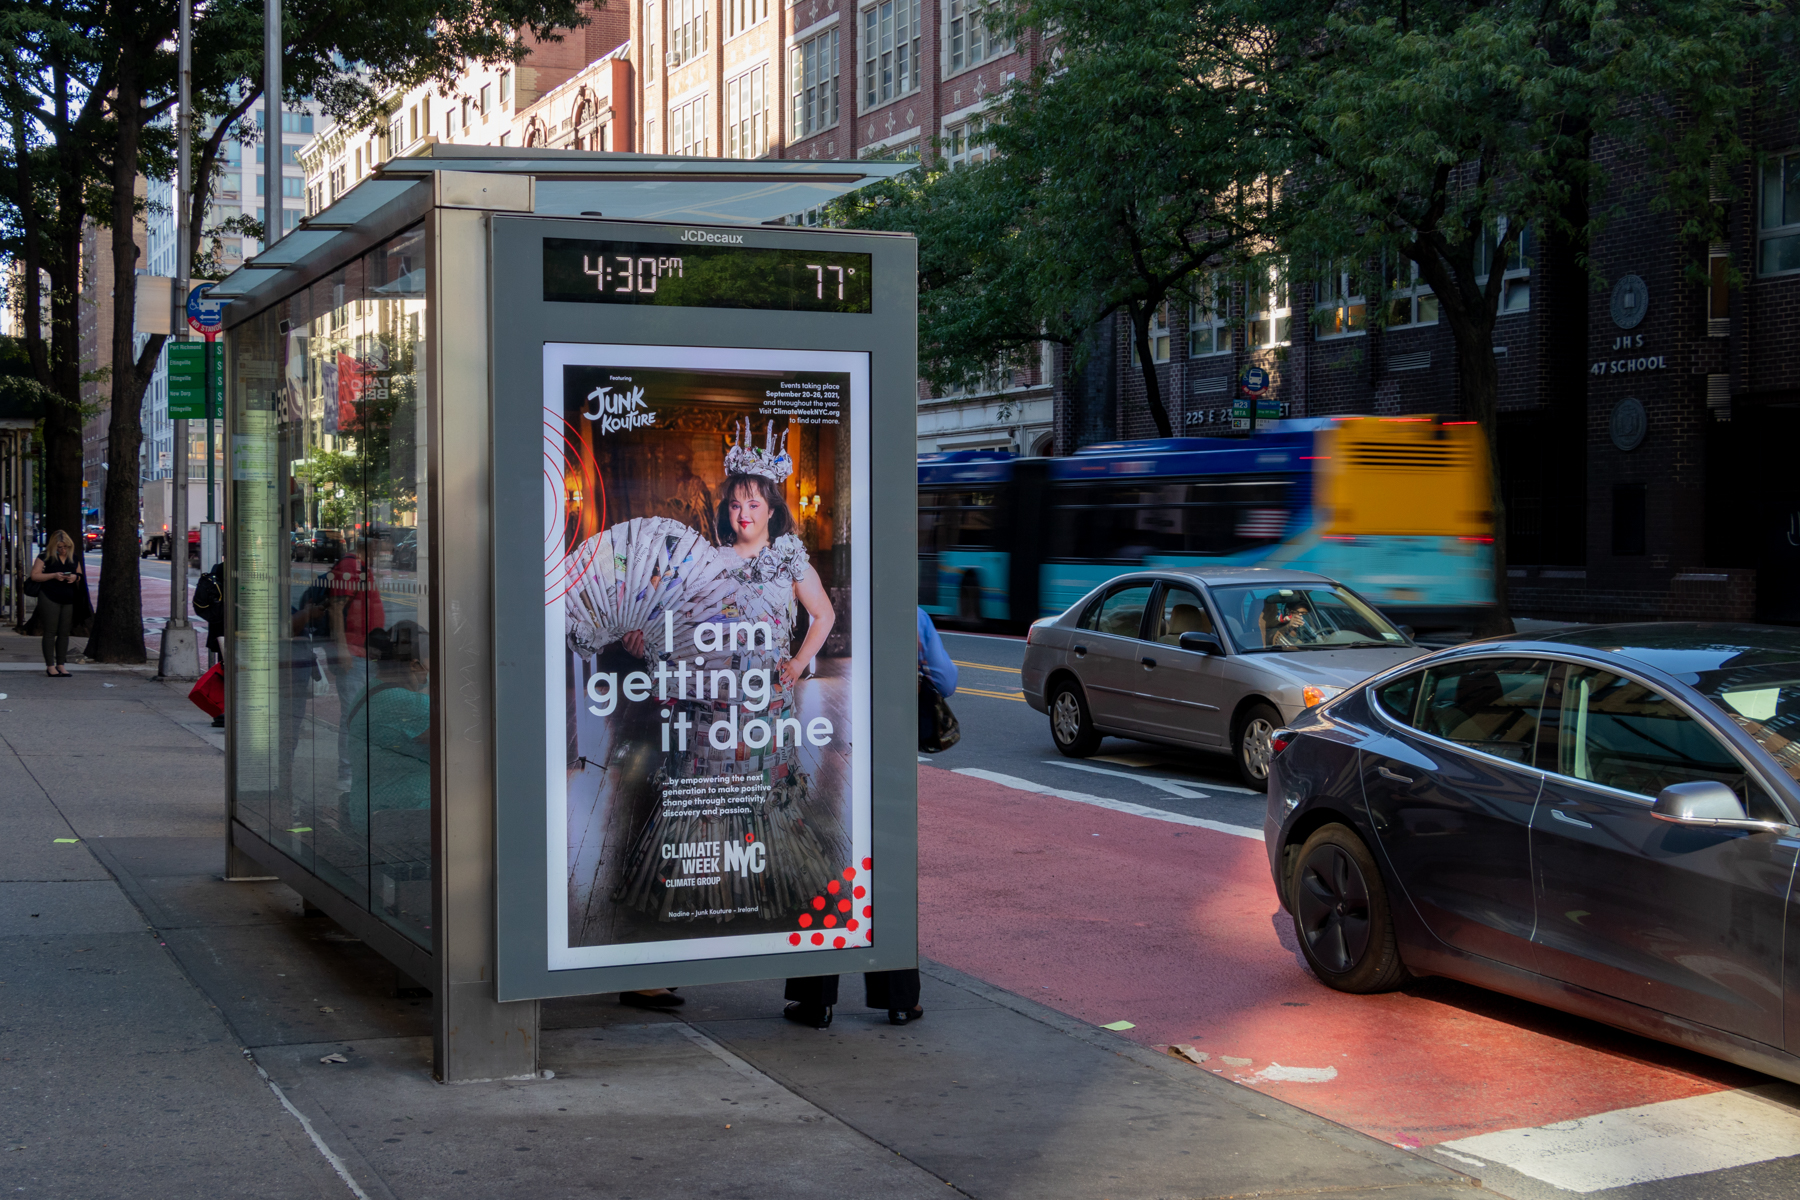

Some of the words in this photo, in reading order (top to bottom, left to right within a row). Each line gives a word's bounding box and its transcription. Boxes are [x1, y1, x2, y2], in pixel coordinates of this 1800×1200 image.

[680, 230, 743, 244] JCDecaux
[583, 255, 656, 293] 4:30
[191, 319, 200, 329] NO
[200, 322, 222, 333] STANDI
[1590, 361, 1607, 376] 47
[1610, 356, 1667, 374] SCHOOL
[802, 382, 821, 391] taking
[765, 390, 801, 398] September
[802, 391, 823, 399] 20-26,
[823, 391, 840, 399] 2021,
[583, 385, 648, 421] JUNK
[777, 399, 812, 408] throughout
[772, 408, 840, 417] ClimateWeekNYC.org
[1186, 410, 1204, 425] 225
[1208, 409, 1215, 422] E
[664, 609, 673, 653] I
[693, 620, 773, 653] am
[587, 656, 771, 717] getting
[661, 709, 692, 752] it
[708, 705, 834, 751] done
[680, 775, 730, 785] empowering
[662, 787, 706, 797] generation
[718, 785, 739, 793] make
[741, 784, 772, 794] positive
[662, 799, 692, 807] change
[694, 796, 726, 806] through
[727, 794, 766, 804] creativity,
[662, 809, 700, 818] discovery
[702, 807, 717, 815] and
[719, 806, 752, 816] passion.
[661, 841, 720, 859] CLIMATE
[724, 839, 766, 878] NYC
[682, 857, 720, 875] WEEK
[665, 878, 695, 888] CLIMATE
[696, 876, 721, 886] GROUP
[695, 909, 709, 918] Junk
